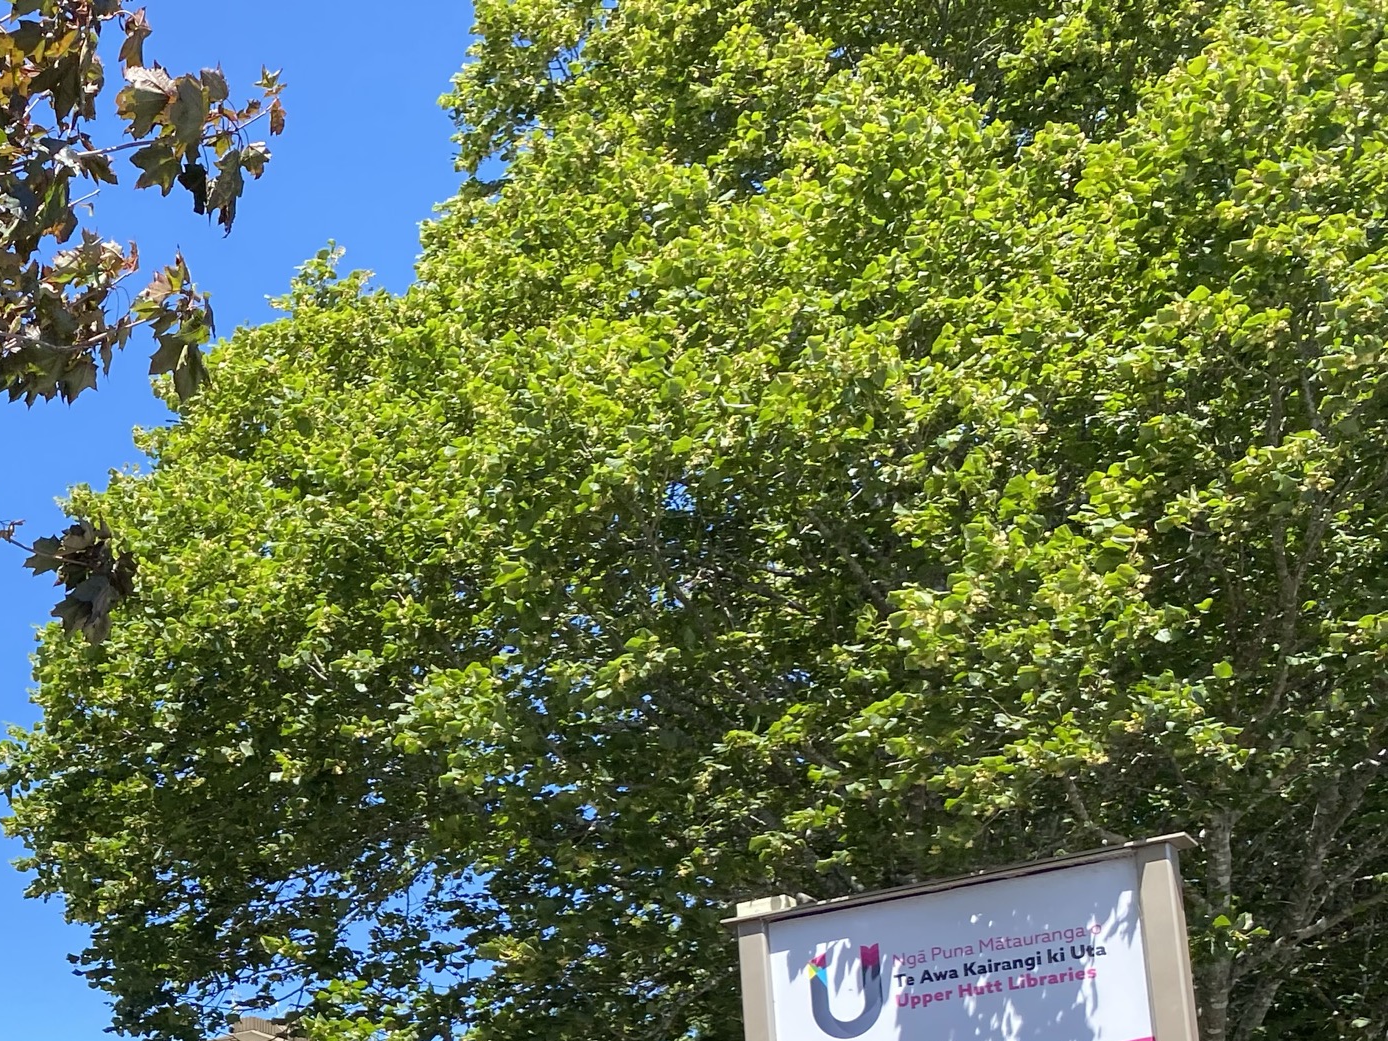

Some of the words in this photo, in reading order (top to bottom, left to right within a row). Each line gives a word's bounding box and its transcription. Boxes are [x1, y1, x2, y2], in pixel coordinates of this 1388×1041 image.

[892, 950, 928, 969] Ngā
[931, 944, 974, 962] Puna
[978, 927, 1087, 952] Mātauranga
[893, 973, 916, 988] Te
[919, 968, 959, 985] Awa
[963, 952, 1042, 977] Kairangi
[1047, 947, 1065, 963] ki
[1070, 943, 1107, 960] Uta
[896, 989, 953, 1010] Upper
[957, 979, 1003, 998] Hutt
[1007, 967, 1097, 991] Libraries
